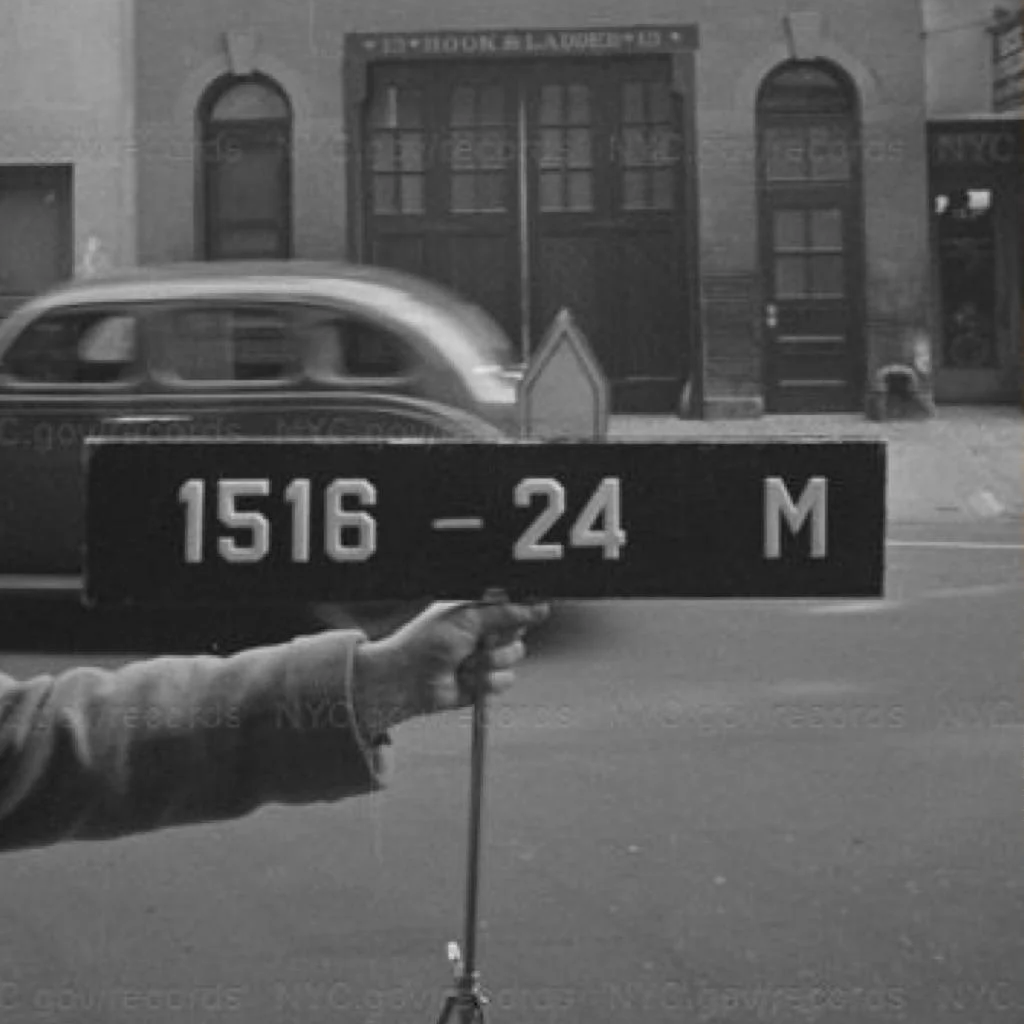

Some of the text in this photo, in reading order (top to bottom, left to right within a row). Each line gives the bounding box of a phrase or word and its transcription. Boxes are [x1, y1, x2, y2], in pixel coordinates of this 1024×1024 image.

[422, 35, 497, 53] HOOK
[178, 477, 377, 564] 1516
[513, 476, 627, 561] 24
[764, 477, 829, 560] M
